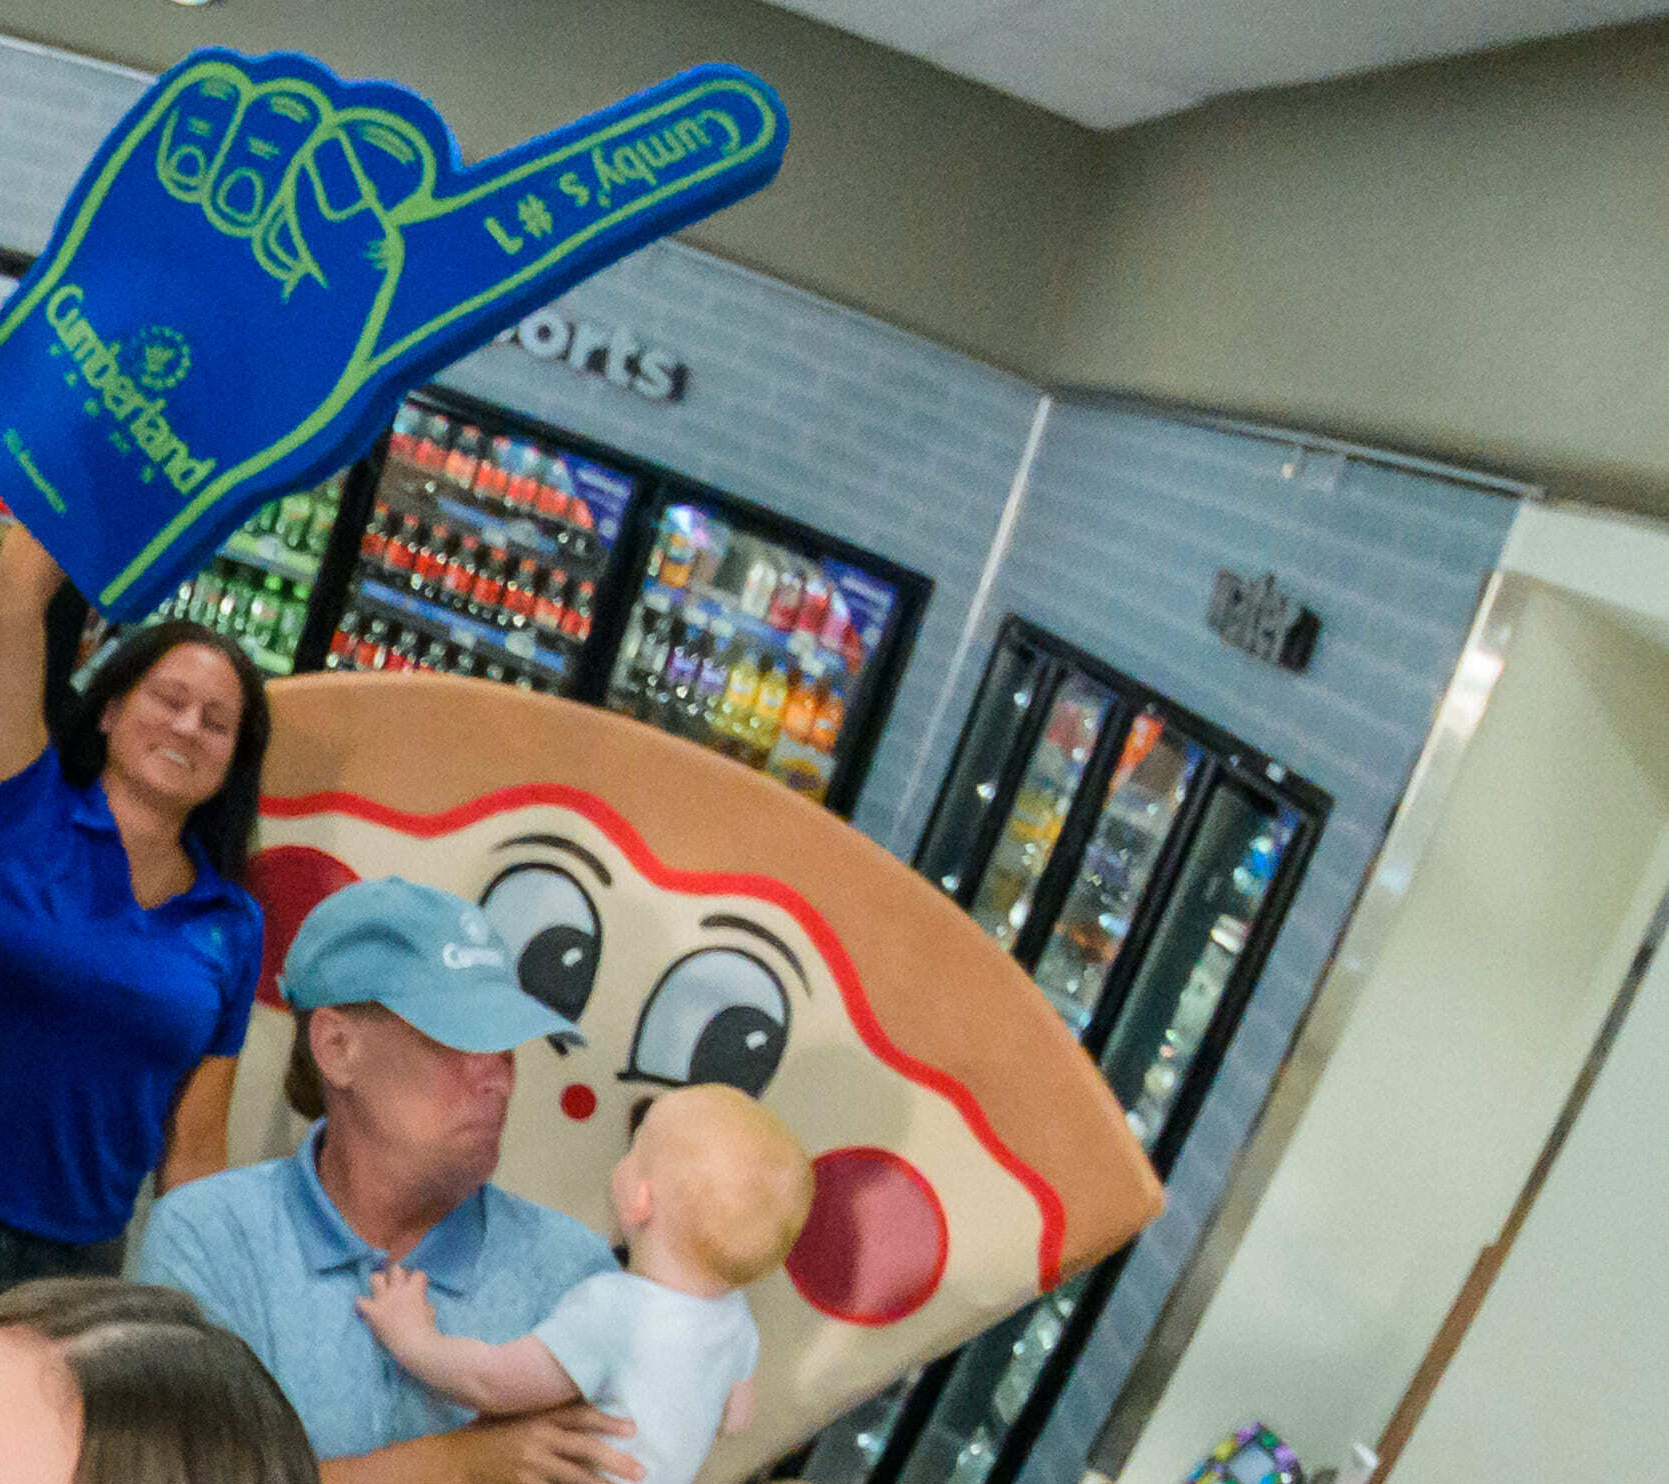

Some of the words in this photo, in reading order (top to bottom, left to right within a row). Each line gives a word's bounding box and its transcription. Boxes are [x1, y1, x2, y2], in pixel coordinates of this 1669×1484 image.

[559, 108, 742, 210] Cumby's
[46, 284, 217, 496] Cumberland
[504, 310, 679, 400] orts
